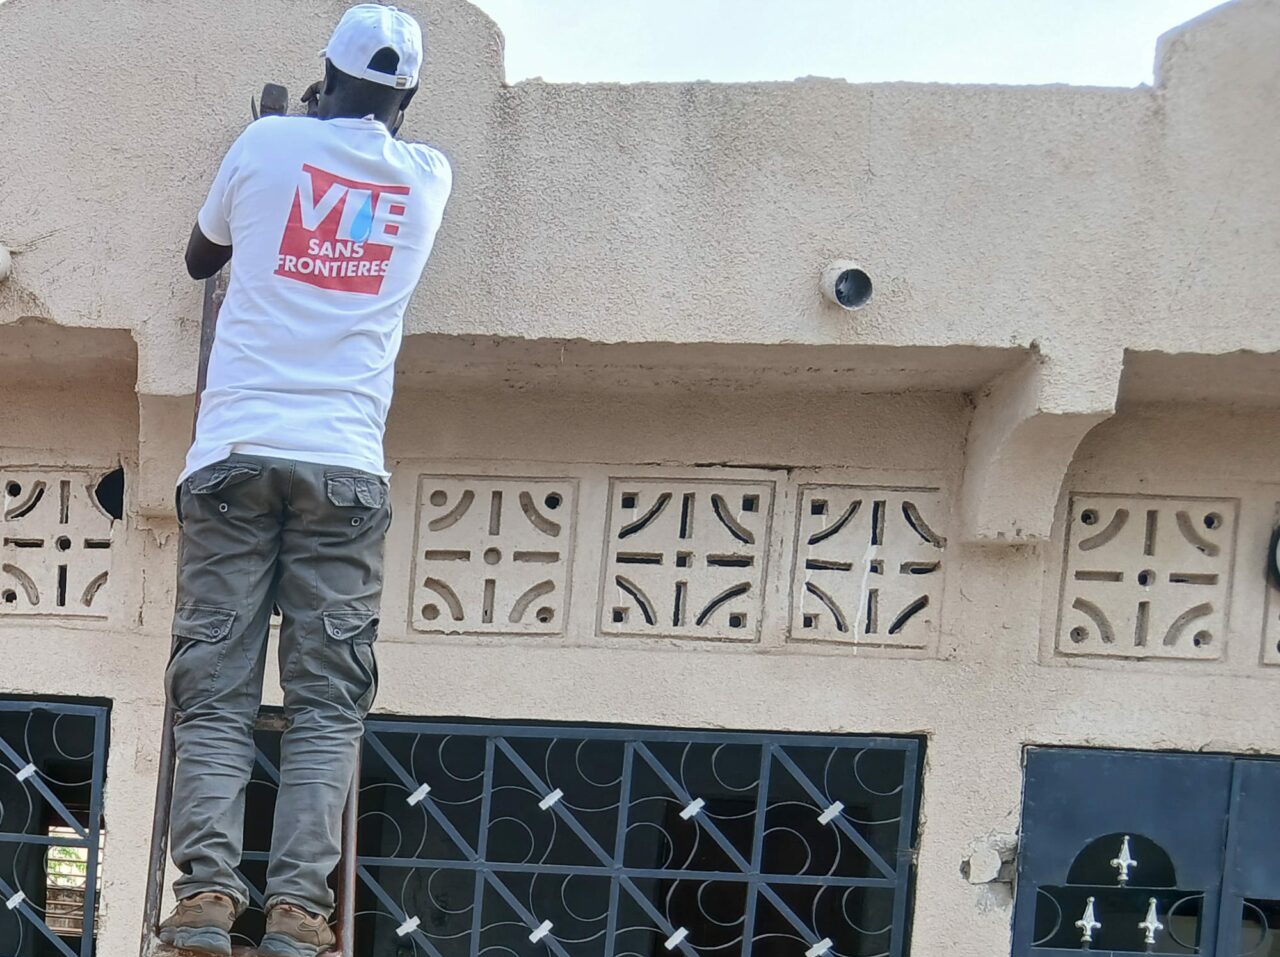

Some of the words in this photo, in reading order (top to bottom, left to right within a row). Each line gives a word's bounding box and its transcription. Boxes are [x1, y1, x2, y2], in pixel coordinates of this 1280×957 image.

[297, 171, 408, 245] VIE
[307, 238, 364, 258] SANS
[275, 254, 389, 278] FRONTIERES
